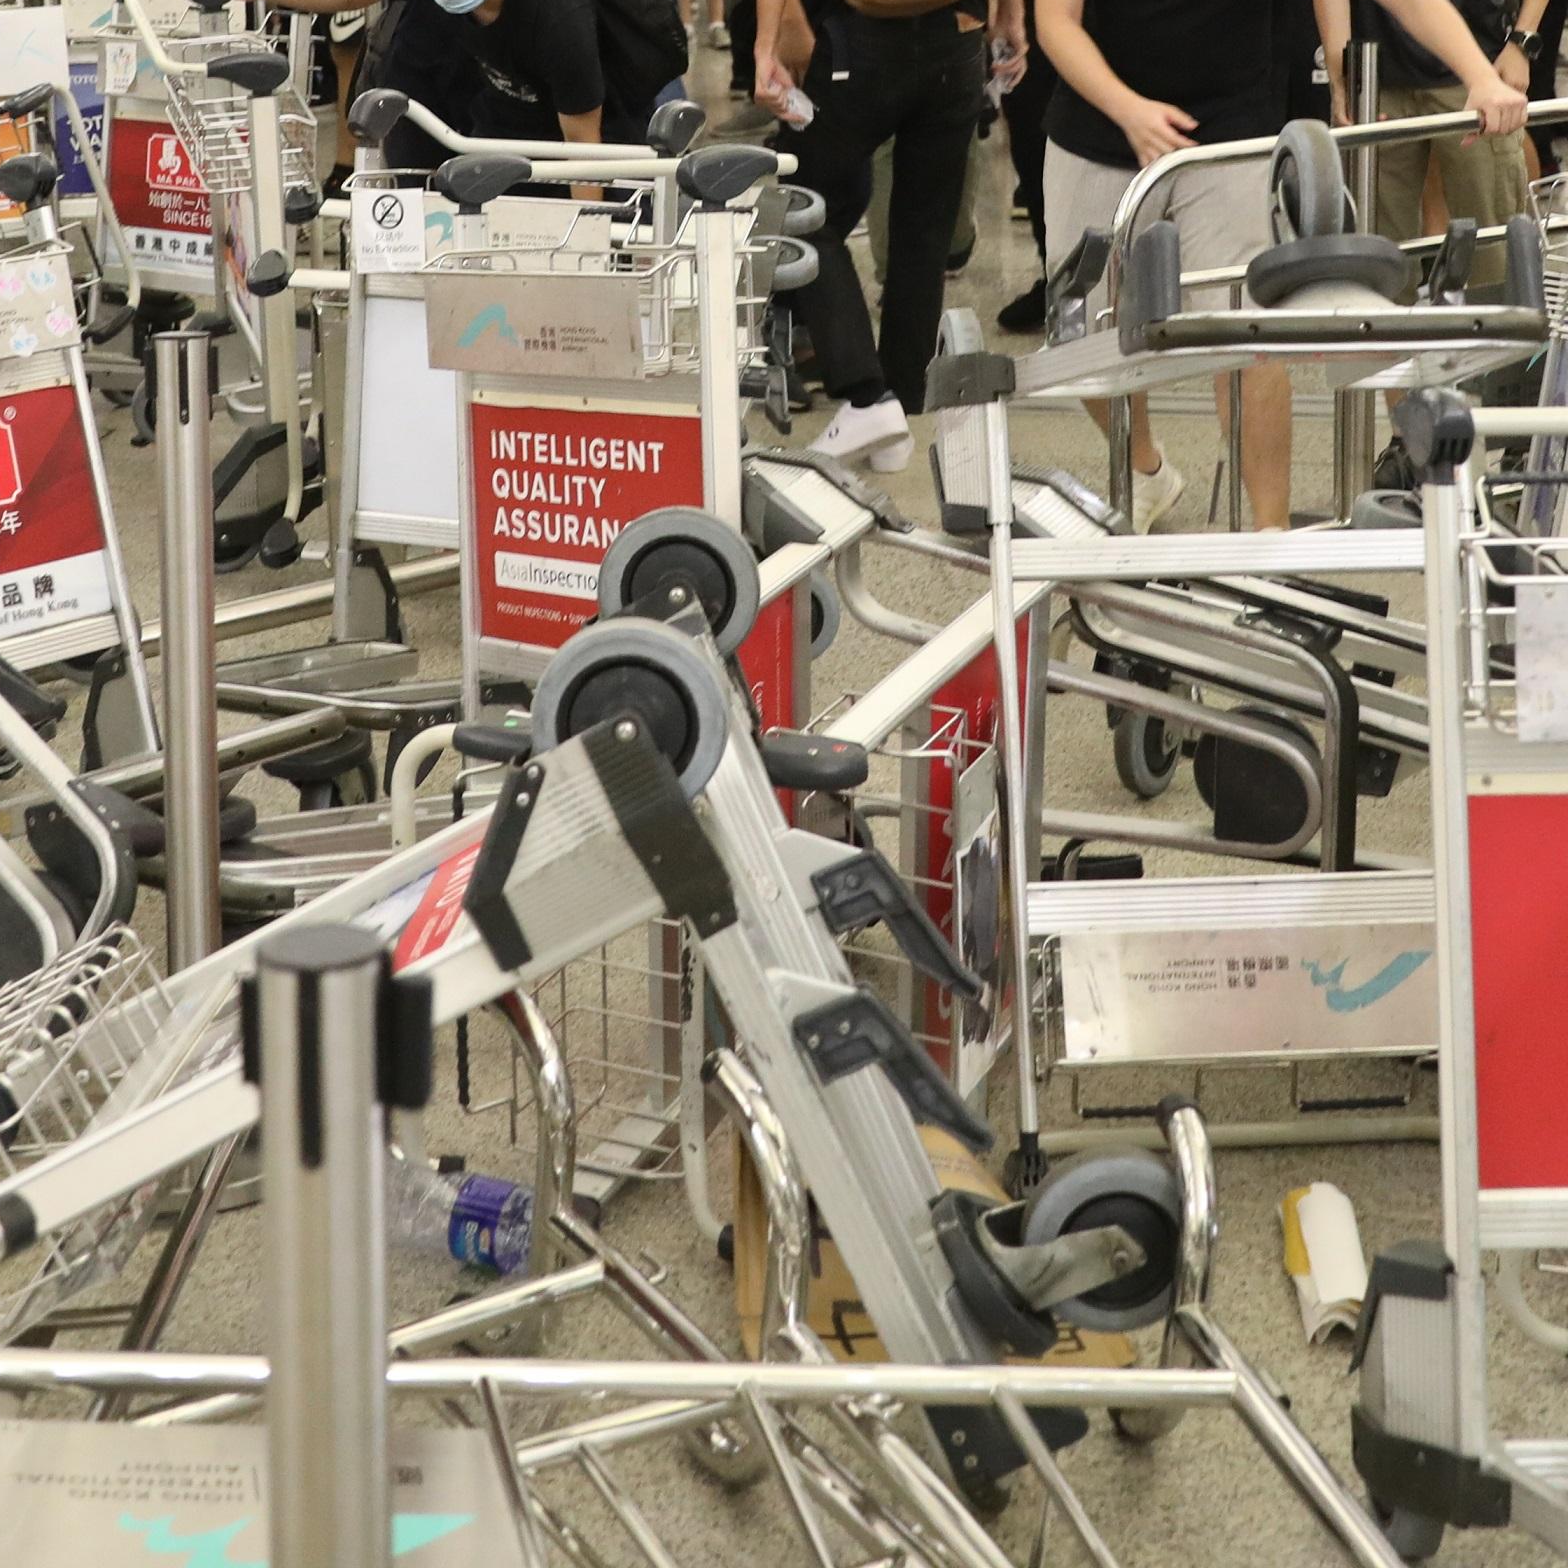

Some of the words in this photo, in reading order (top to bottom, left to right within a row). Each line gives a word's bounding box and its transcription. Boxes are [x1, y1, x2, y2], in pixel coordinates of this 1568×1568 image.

[149, 191, 211, 211] 始創於一八
[163, 210, 212, 227] SINCE18
[134, 234, 213, 255] 香港中成藥
[490, 429, 664, 474] INTELLIGENT
[492, 468, 606, 509] QUALITY
[494, 506, 622, 550] ASSURAN
[500, 559, 598, 591] AsiaInspectio
[12, 601, 44, 624] Hong
[47, 595, 79, 615] Kong
